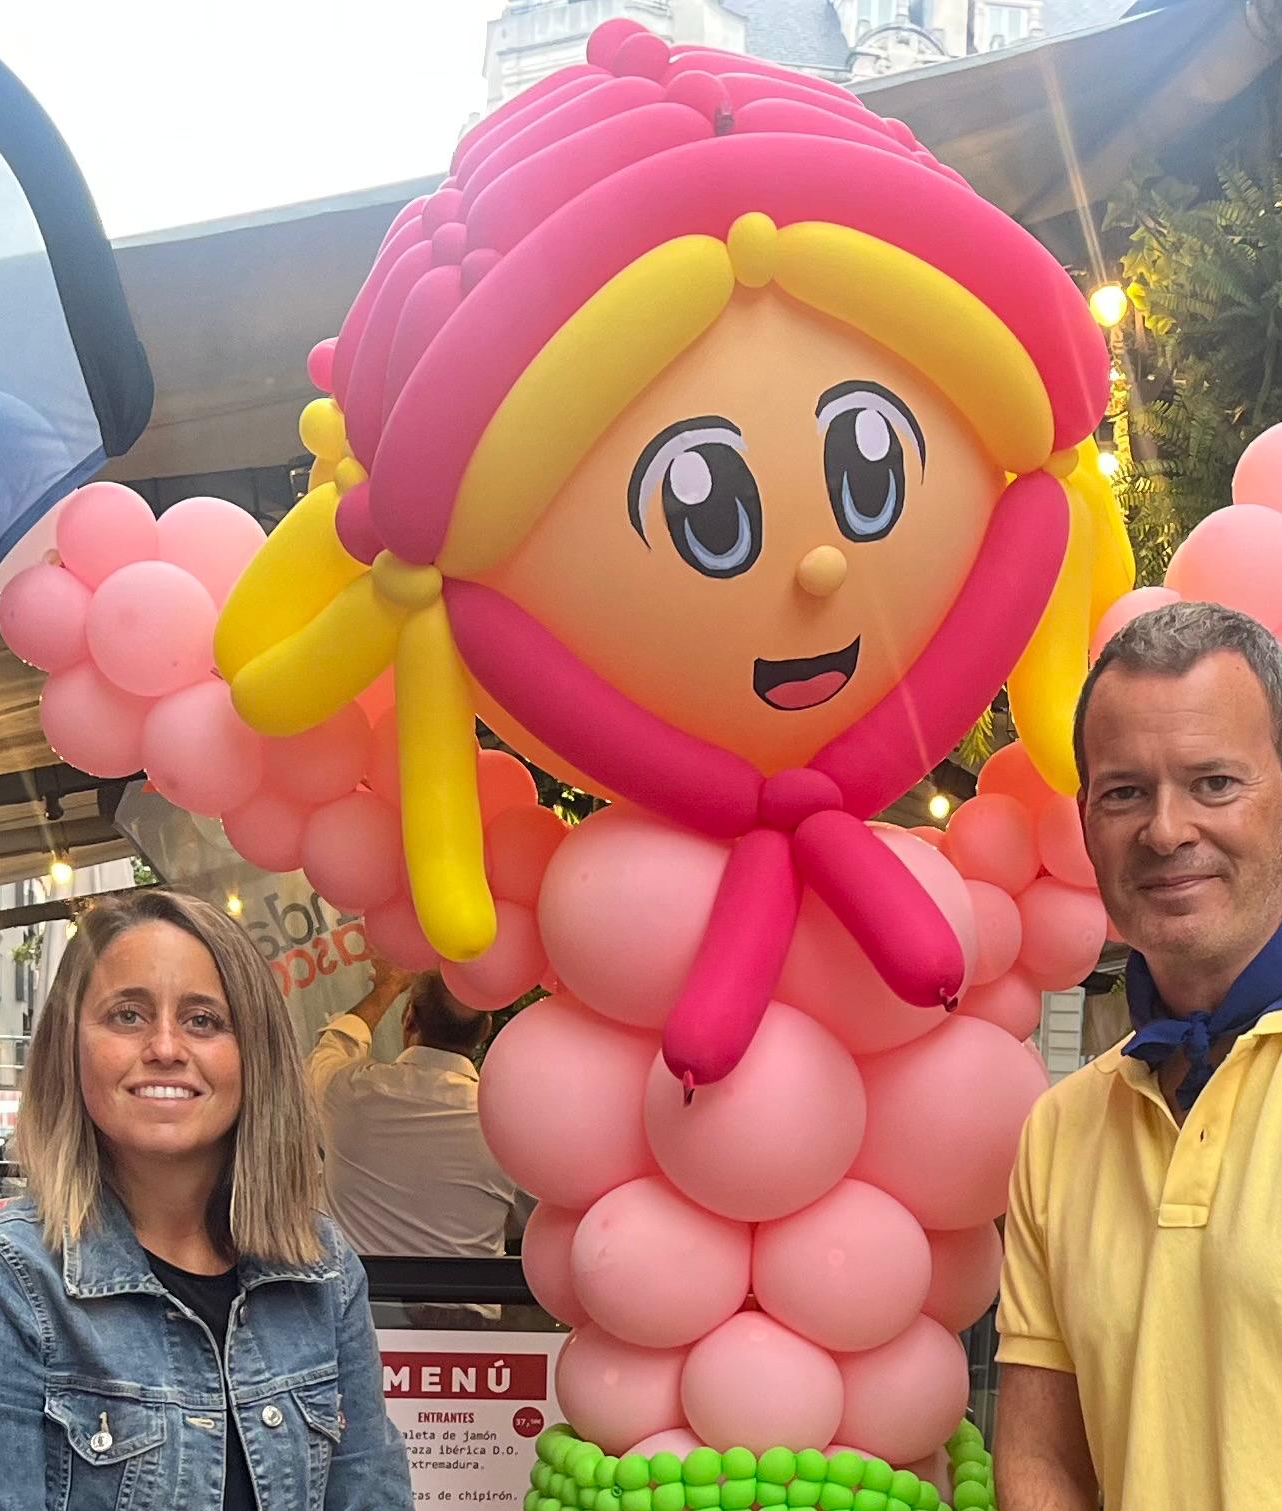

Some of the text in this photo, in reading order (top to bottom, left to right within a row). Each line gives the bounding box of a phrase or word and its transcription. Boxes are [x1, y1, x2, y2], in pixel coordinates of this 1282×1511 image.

[383, 1359, 511, 1393] MENÚ
[418, 1412, 475, 1424] ENTRANTES
[403, 1429, 497, 1443] aleta de jamón
[439, 1444, 486, 1455] ibérica
[492, 1445, 519, 1456] D.O.
[409, 1460, 485, 1470] xtremadura.
[437, 1490, 452, 1501] de
[458, 1490, 518, 1503] chipirón.
